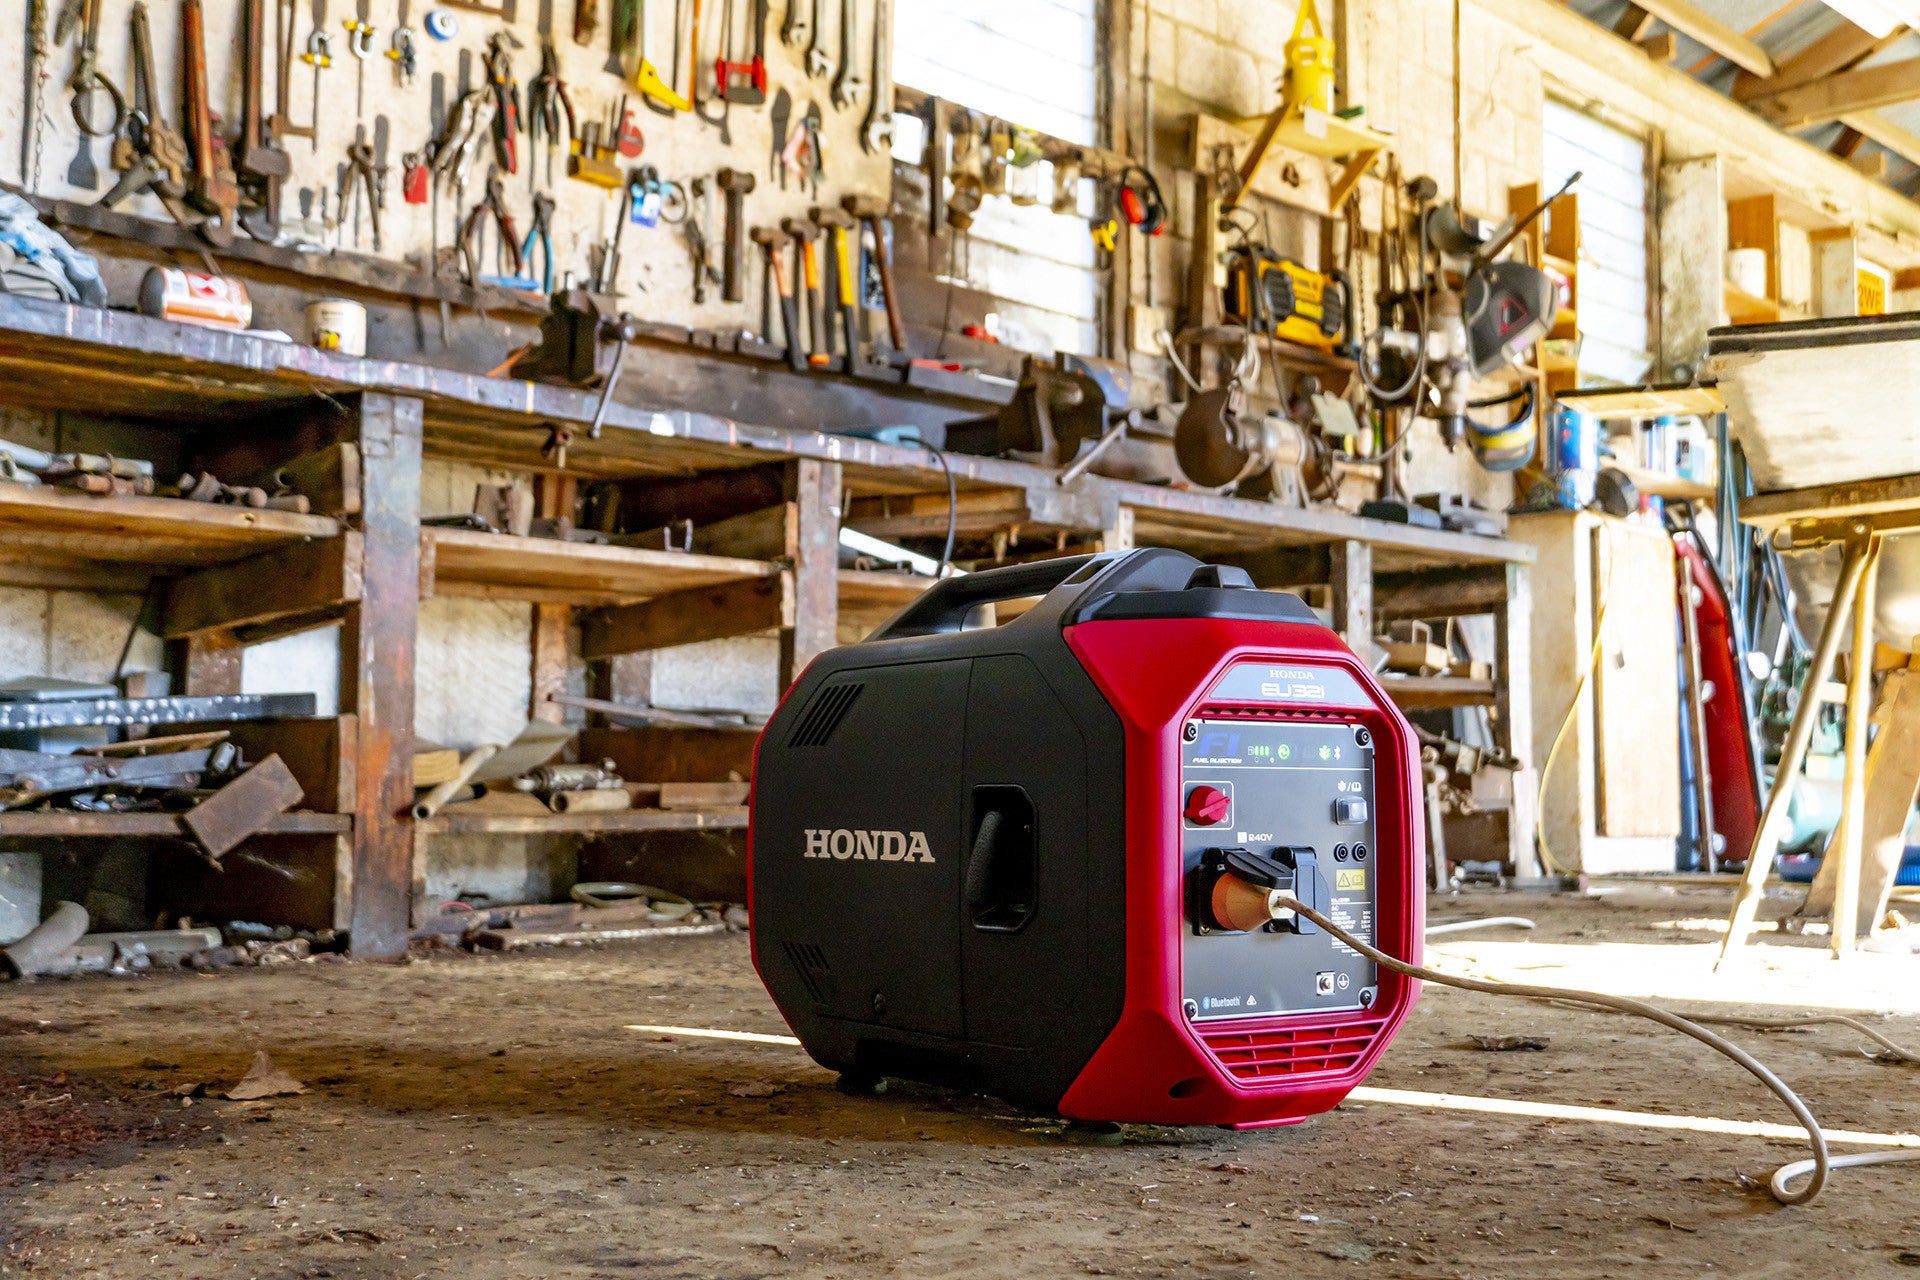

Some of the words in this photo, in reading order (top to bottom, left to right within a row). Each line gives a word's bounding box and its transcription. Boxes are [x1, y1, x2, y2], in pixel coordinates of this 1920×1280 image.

[1269, 669, 1315, 680] HONDA
[1248, 833, 1273, 842] 240V
[803, 828, 936, 863] HONDA
[1210, 996, 1240, 1008] Bluetooth
